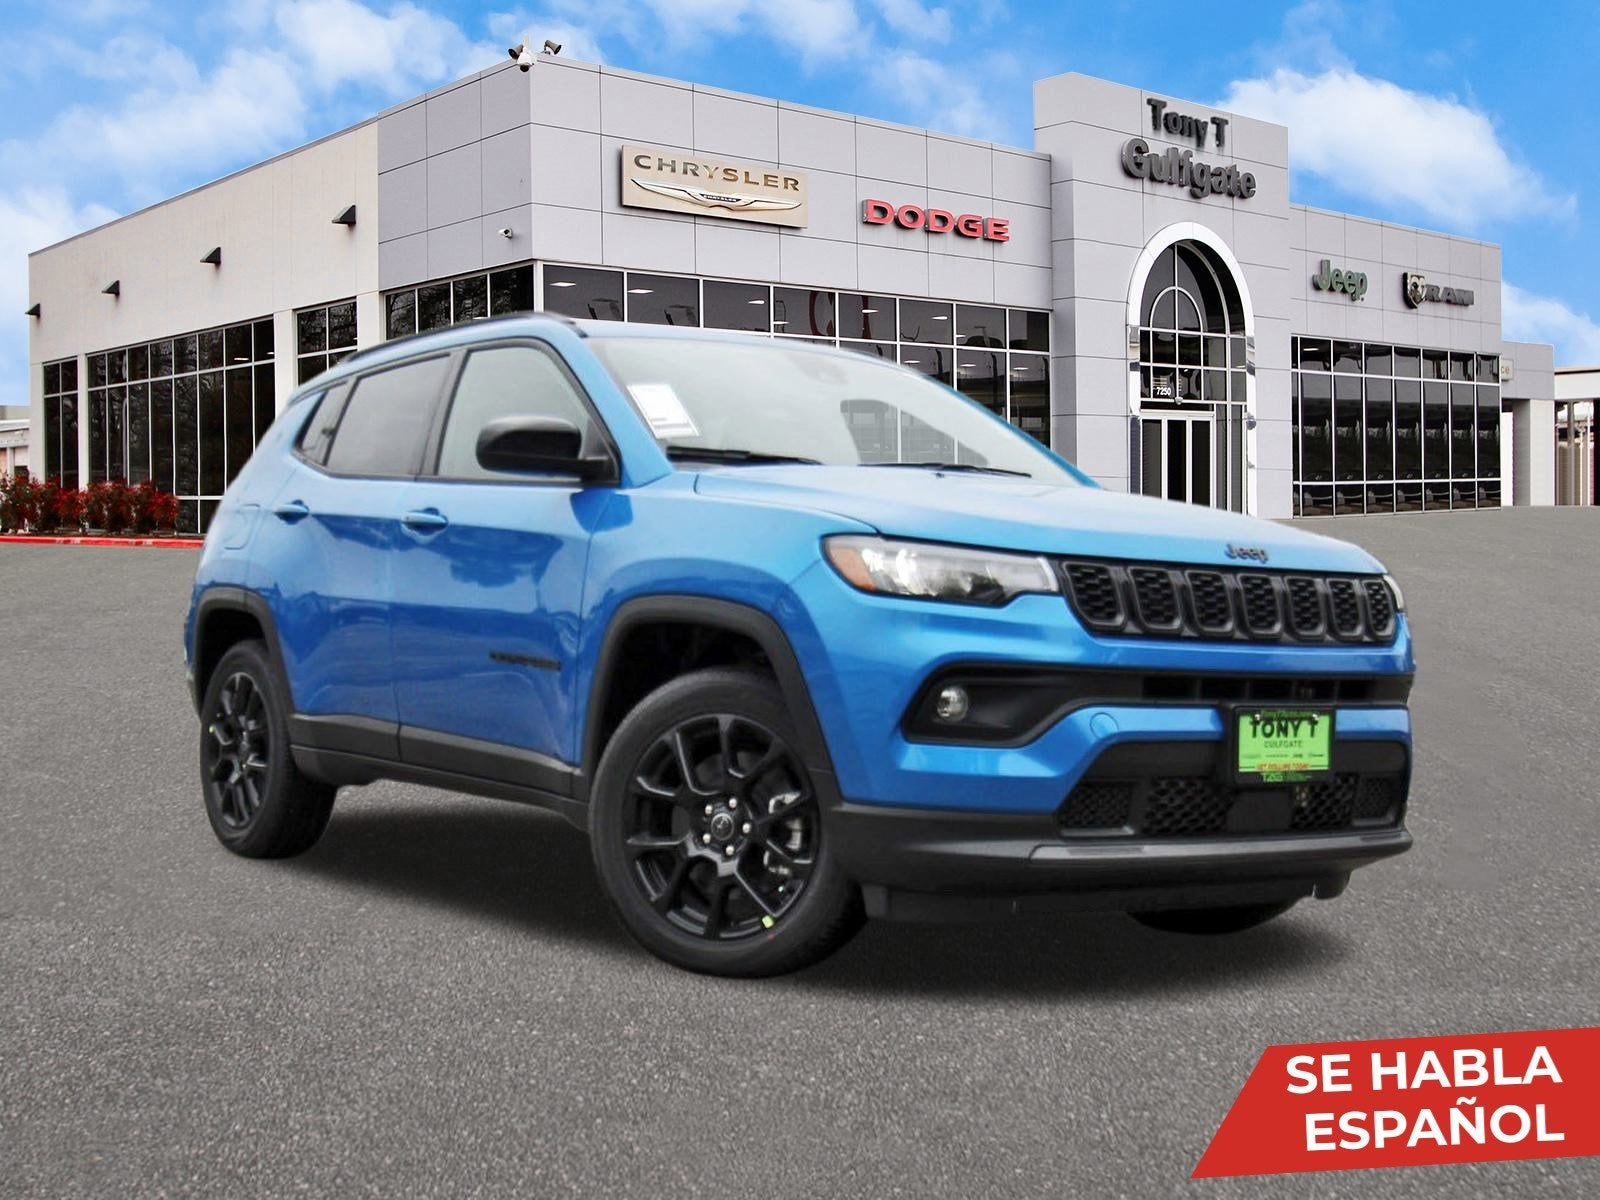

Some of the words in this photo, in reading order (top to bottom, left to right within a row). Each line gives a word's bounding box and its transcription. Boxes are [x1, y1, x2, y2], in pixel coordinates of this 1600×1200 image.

[1146, 98, 1208, 147] Tony
[1210, 116, 1229, 147] T
[634, 154, 799, 191] CHRYSLER
[1121, 138, 1256, 198] Gulfgate
[862, 199, 1010, 242] DODGE
[1312, 259, 1368, 301] Jeep
[1425, 284, 1475, 306] RAM
[1225, 543, 1269, 564] Jeep
[1249, 717, 1303, 738] TONY
